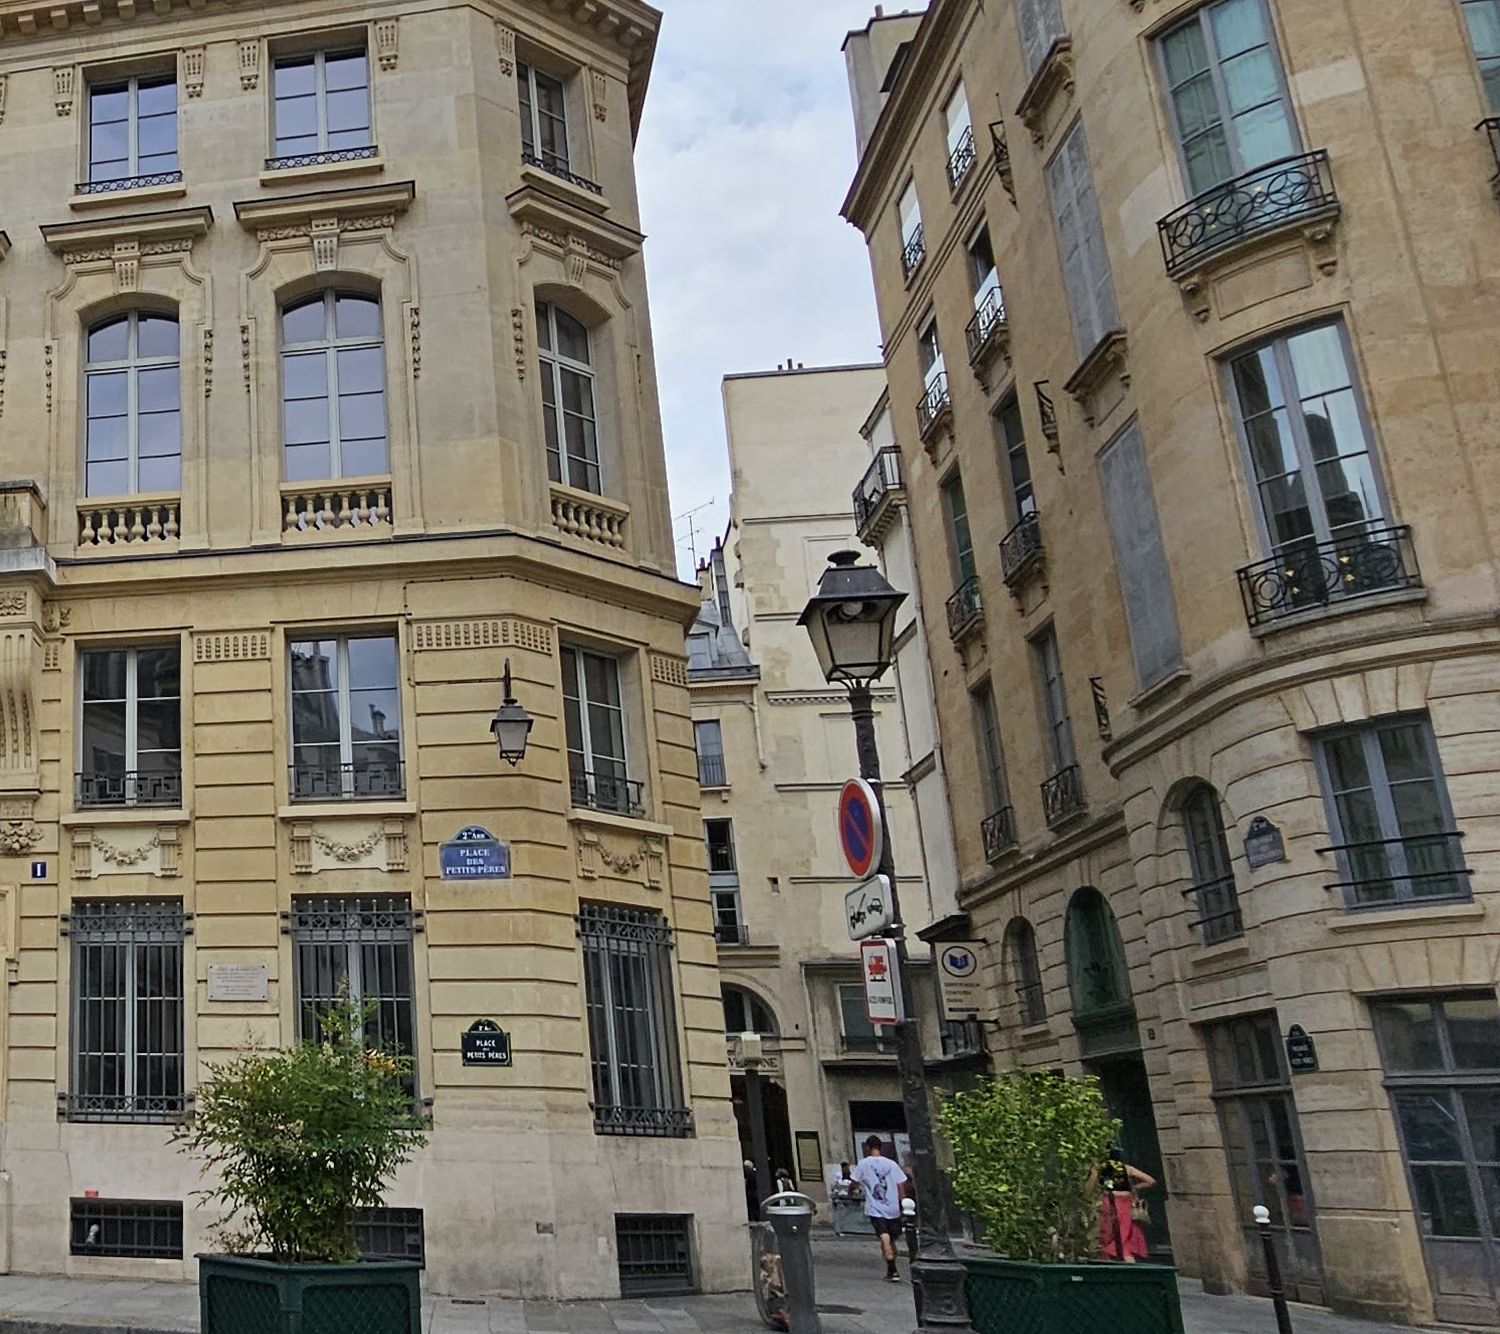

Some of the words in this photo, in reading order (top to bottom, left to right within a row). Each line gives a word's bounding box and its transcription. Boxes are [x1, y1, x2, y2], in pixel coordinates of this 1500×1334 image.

[460, 849, 490, 857] PLACE
[466, 858, 484, 866] DES
[476, 1039, 496, 1047] PLACE
[466, 1051, 486, 1059] PETITS
[487, 1049, 507, 1059] PÈRES
